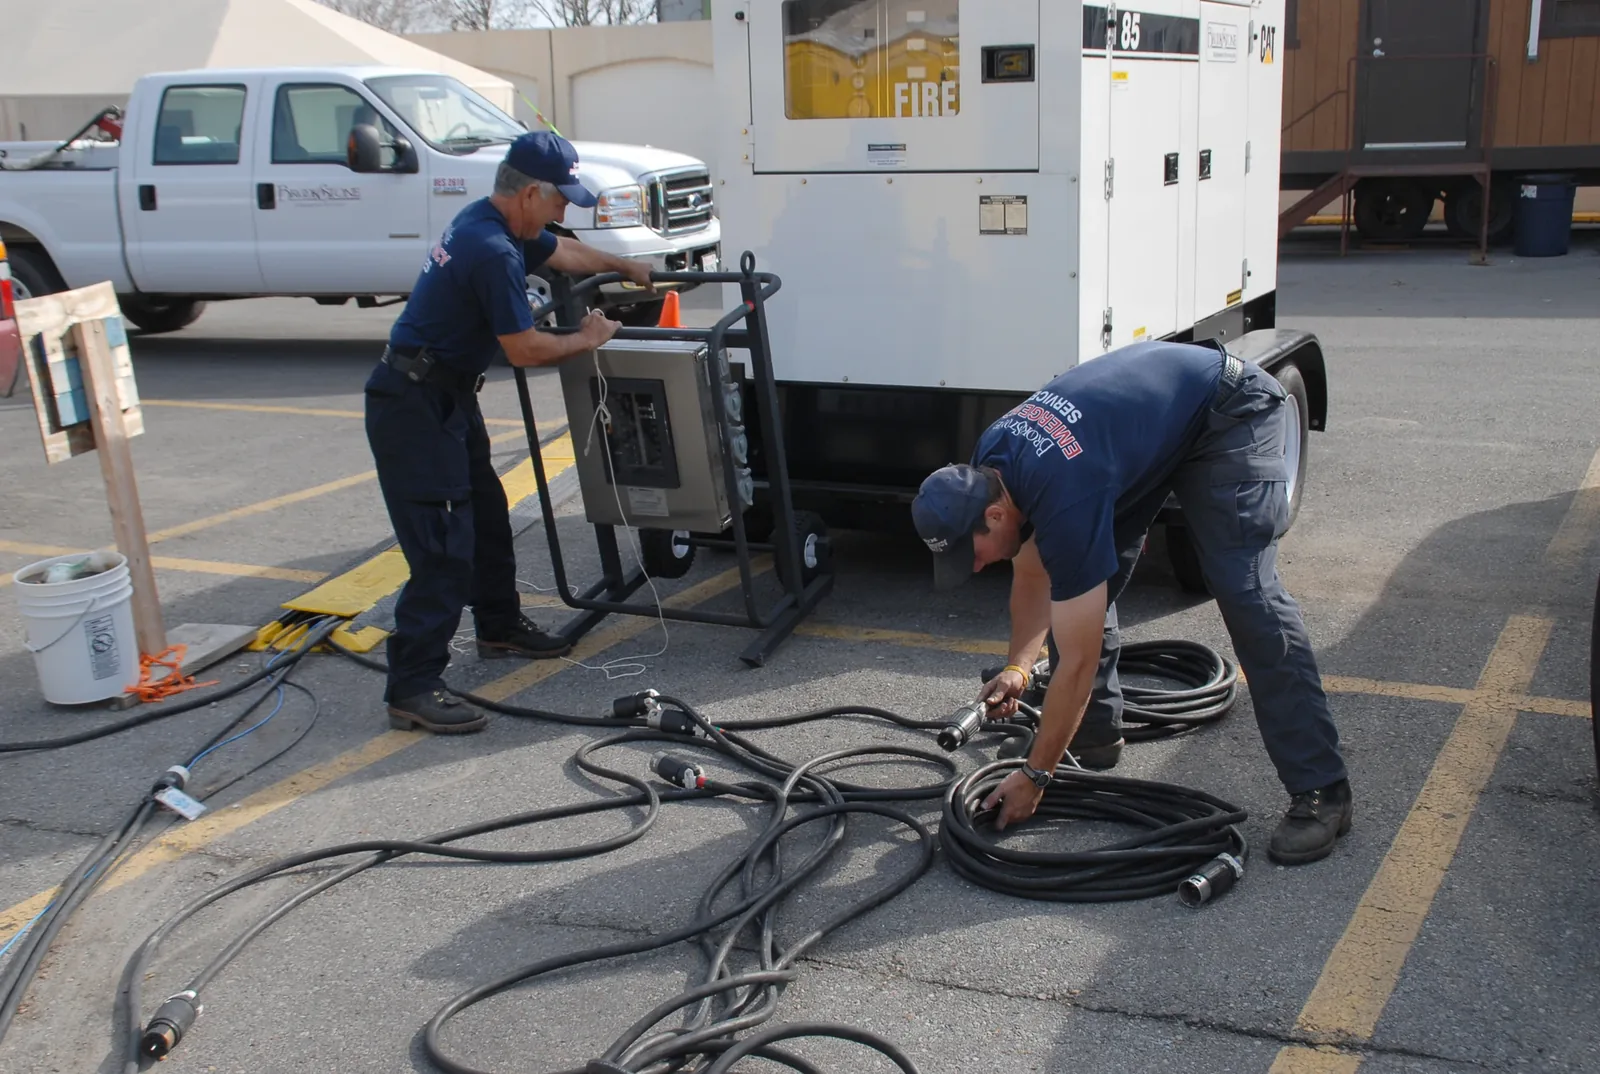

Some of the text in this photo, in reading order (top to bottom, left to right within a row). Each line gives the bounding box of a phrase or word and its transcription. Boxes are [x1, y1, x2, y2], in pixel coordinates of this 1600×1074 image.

[1120, 11, 1141, 50] 85
[1260, 24, 1276, 63] CAT
[894, 80, 957, 118] FIRE
